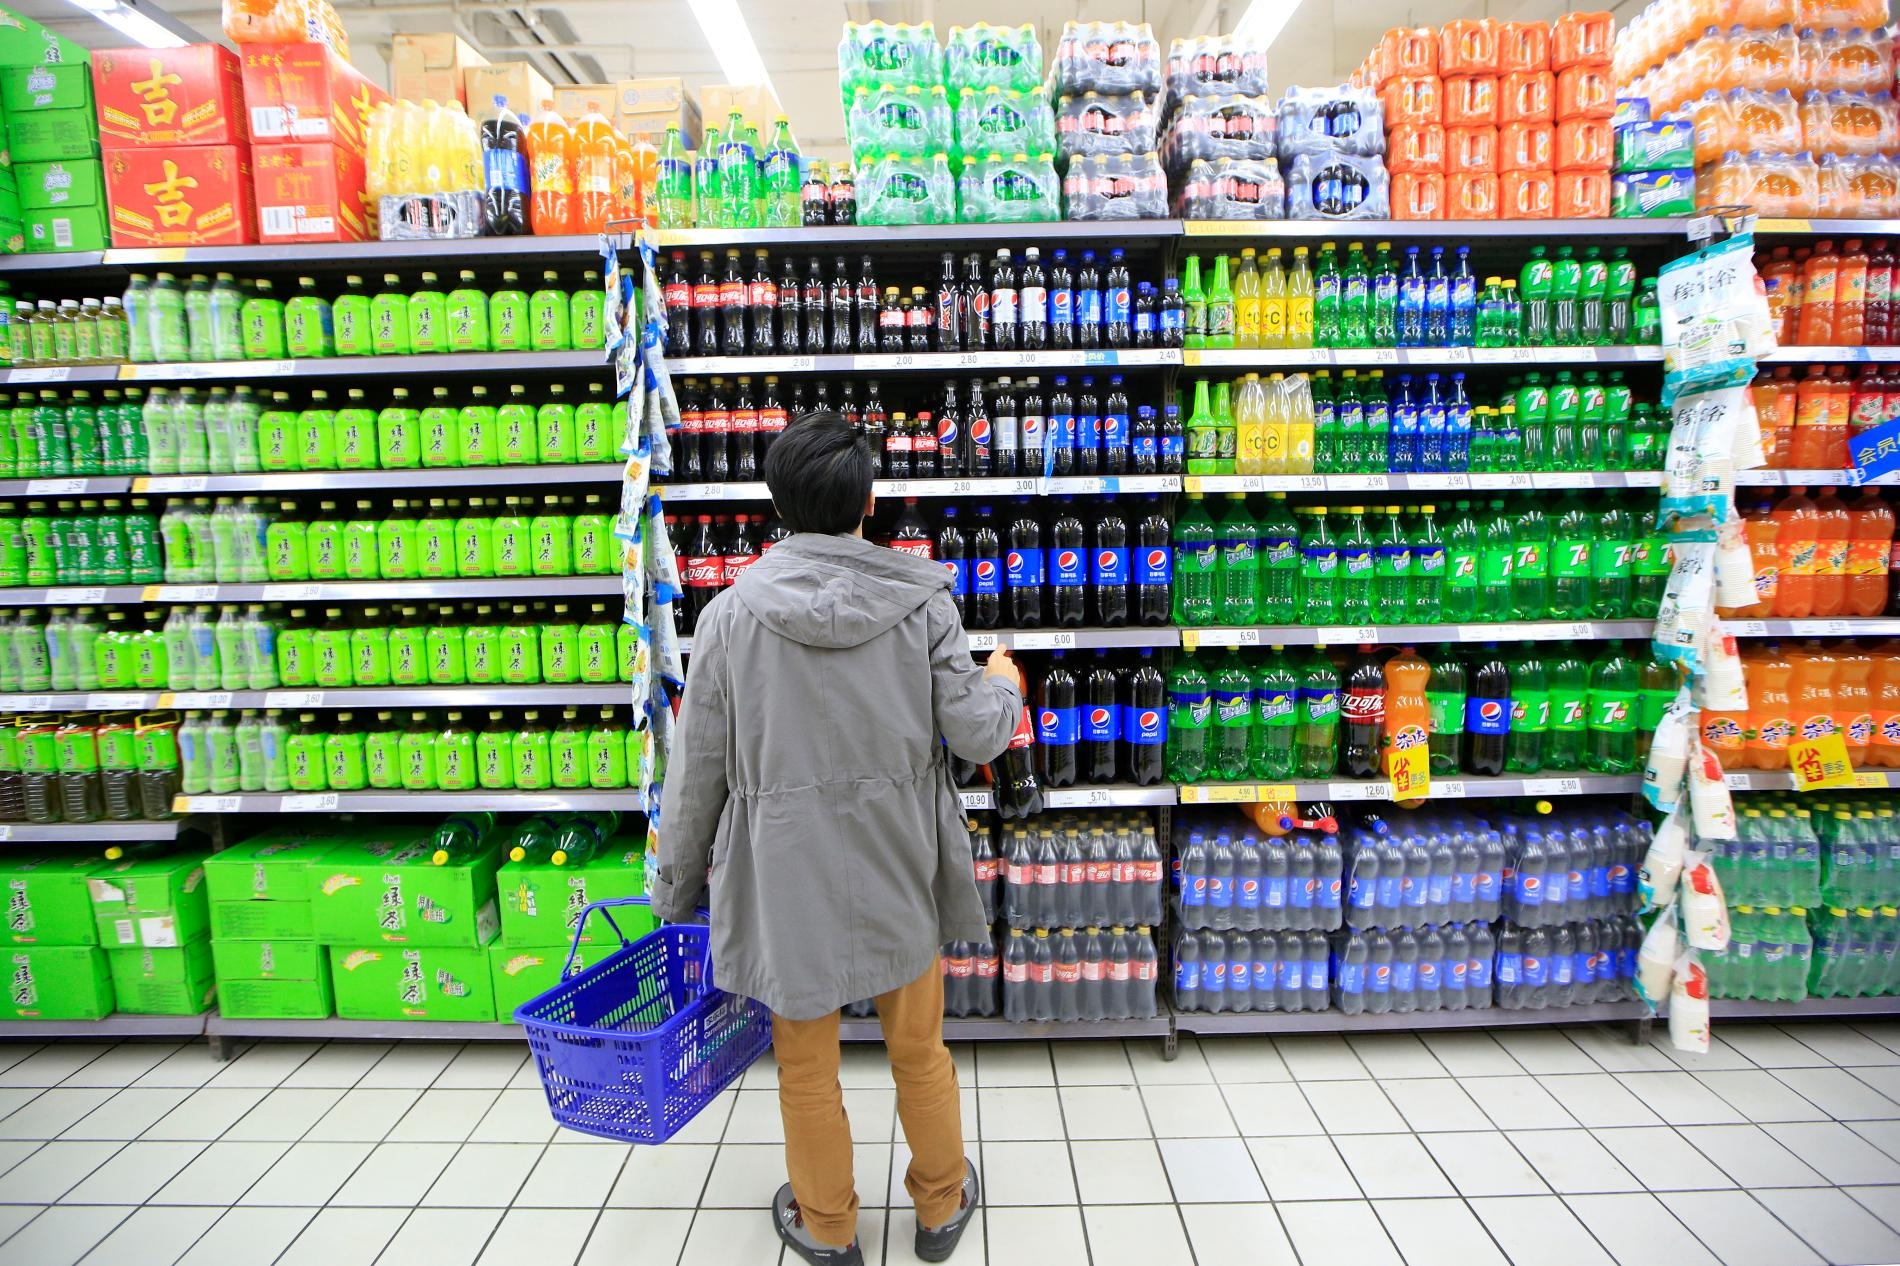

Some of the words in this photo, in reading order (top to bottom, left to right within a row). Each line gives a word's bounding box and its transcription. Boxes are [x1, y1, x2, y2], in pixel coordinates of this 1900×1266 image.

[131, 59, 182, 126] 吉
[144, 160, 199, 227] 吉
[1020, 354, 1036, 363] 3.00
[1160, 350, 1176, 359] 2.40
[897, 356, 912, 365] 2.00
[961, 355, 977, 364] 2.80
[1857, 432, 1900, 466] 会员
[1016, 480, 1033, 490] 3.00
[1162, 478, 1178, 487] 2.40
[1243, 479, 1259, 487] 2.80
[1301, 477, 1322, 487] 13.50
[1368, 477, 1384, 486] 2.90
[891, 484, 907, 492] 2.00
[954, 482, 971, 492] 2.80
[1240, 632, 1257, 640] 6.50
[1359, 630, 1375, 638] 5.30
[977, 637, 993, 645] 5.20
[1054, 635, 1071, 644] 6.00
[1341, 694, 1385, 710] 可口可乐
[1219, 703, 1248, 719] 雪碧
[1261, 702, 1293, 718] 雪碧
[1309, 701, 1339, 717] 雪碧
[1397, 732, 1426, 748] 芬达
[1561, 781, 1577, 790] 5.80
[1365, 786, 1385, 796] 12.60
[966, 795, 986, 805] 10.90
[1091, 792, 1107, 801] 5.70
